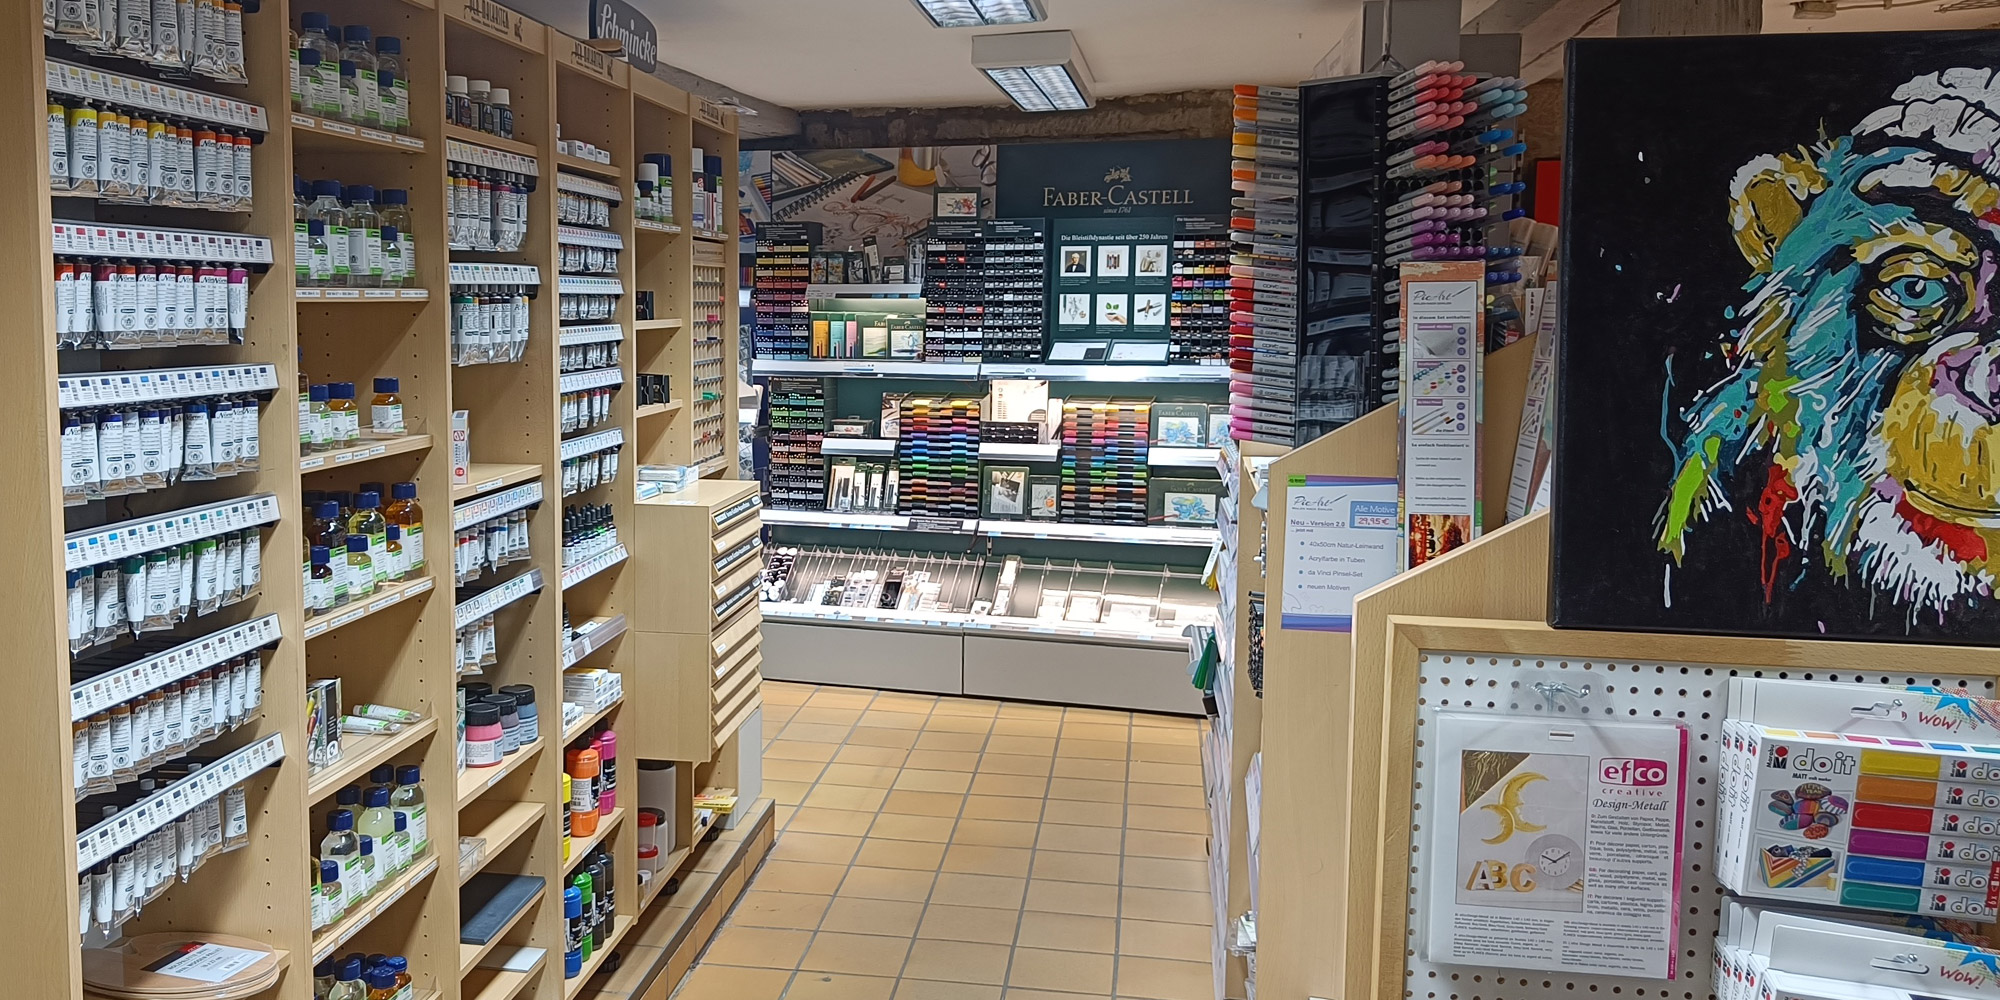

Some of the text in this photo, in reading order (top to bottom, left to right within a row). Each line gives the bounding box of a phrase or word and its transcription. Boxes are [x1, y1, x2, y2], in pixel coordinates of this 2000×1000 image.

[597, 4, 656, 65] Schmincke
[78, 119, 97, 127] Norm
[1043, 185, 1194, 206] FABER-CASTELL
[1370, 505, 1395, 513] Motive
[1919, 712, 1962, 734] WOW!
[1793, 748, 1856, 775] doit
[1604, 760, 1665, 783] efco
[1972, 762, 2000, 781] do
[1602, 788, 1663, 797] creative
[1968, 790, 2000, 808] do
[1592, 798, 1669, 812] Design-Metall
[1963, 816, 2000, 835] doi
[1959, 843, 2000, 862] doi
[1955, 870, 1987, 888] do
[1951, 897, 1997, 916] do
[1940, 966, 1986, 990] WOW!
